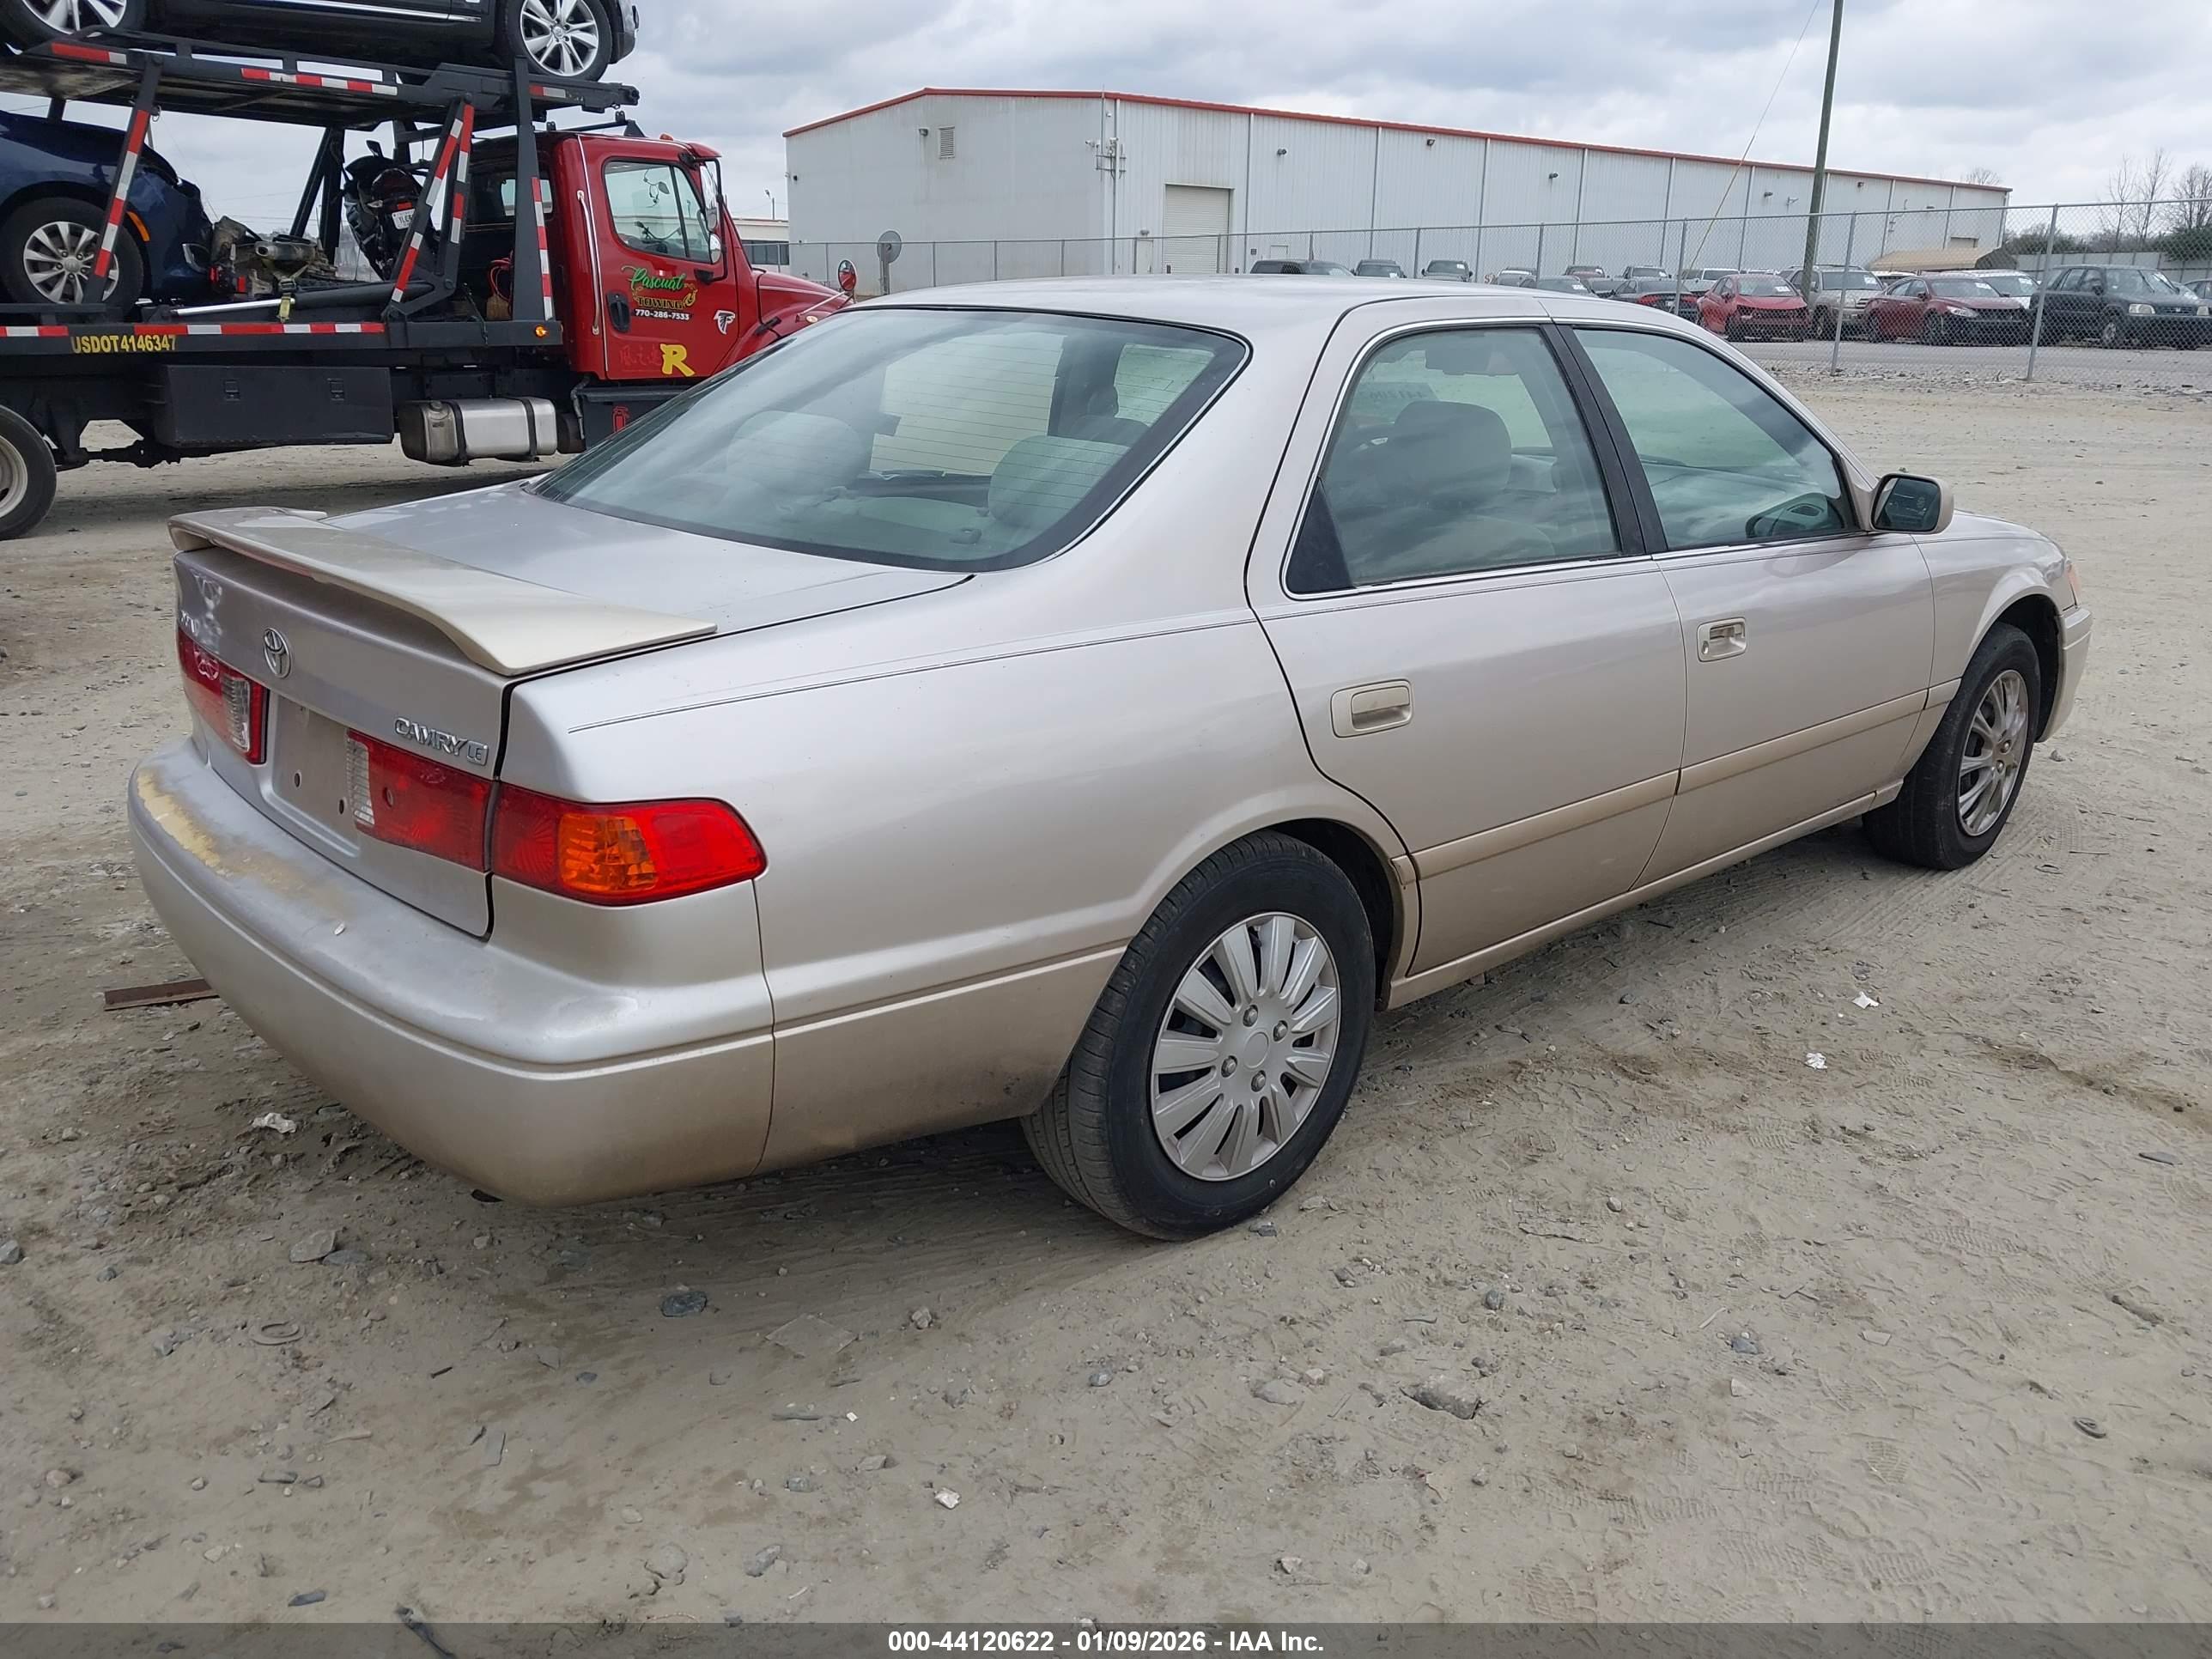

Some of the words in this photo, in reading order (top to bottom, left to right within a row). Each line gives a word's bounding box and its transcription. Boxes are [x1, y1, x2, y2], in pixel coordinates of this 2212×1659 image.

[635, 308, 690, 320] 770-286-7533
[636, 296, 684, 309] TOWING
[659, 343, 696, 377] R
[395, 717, 467, 756] CAMRY
[466, 742, 483, 762] LE
